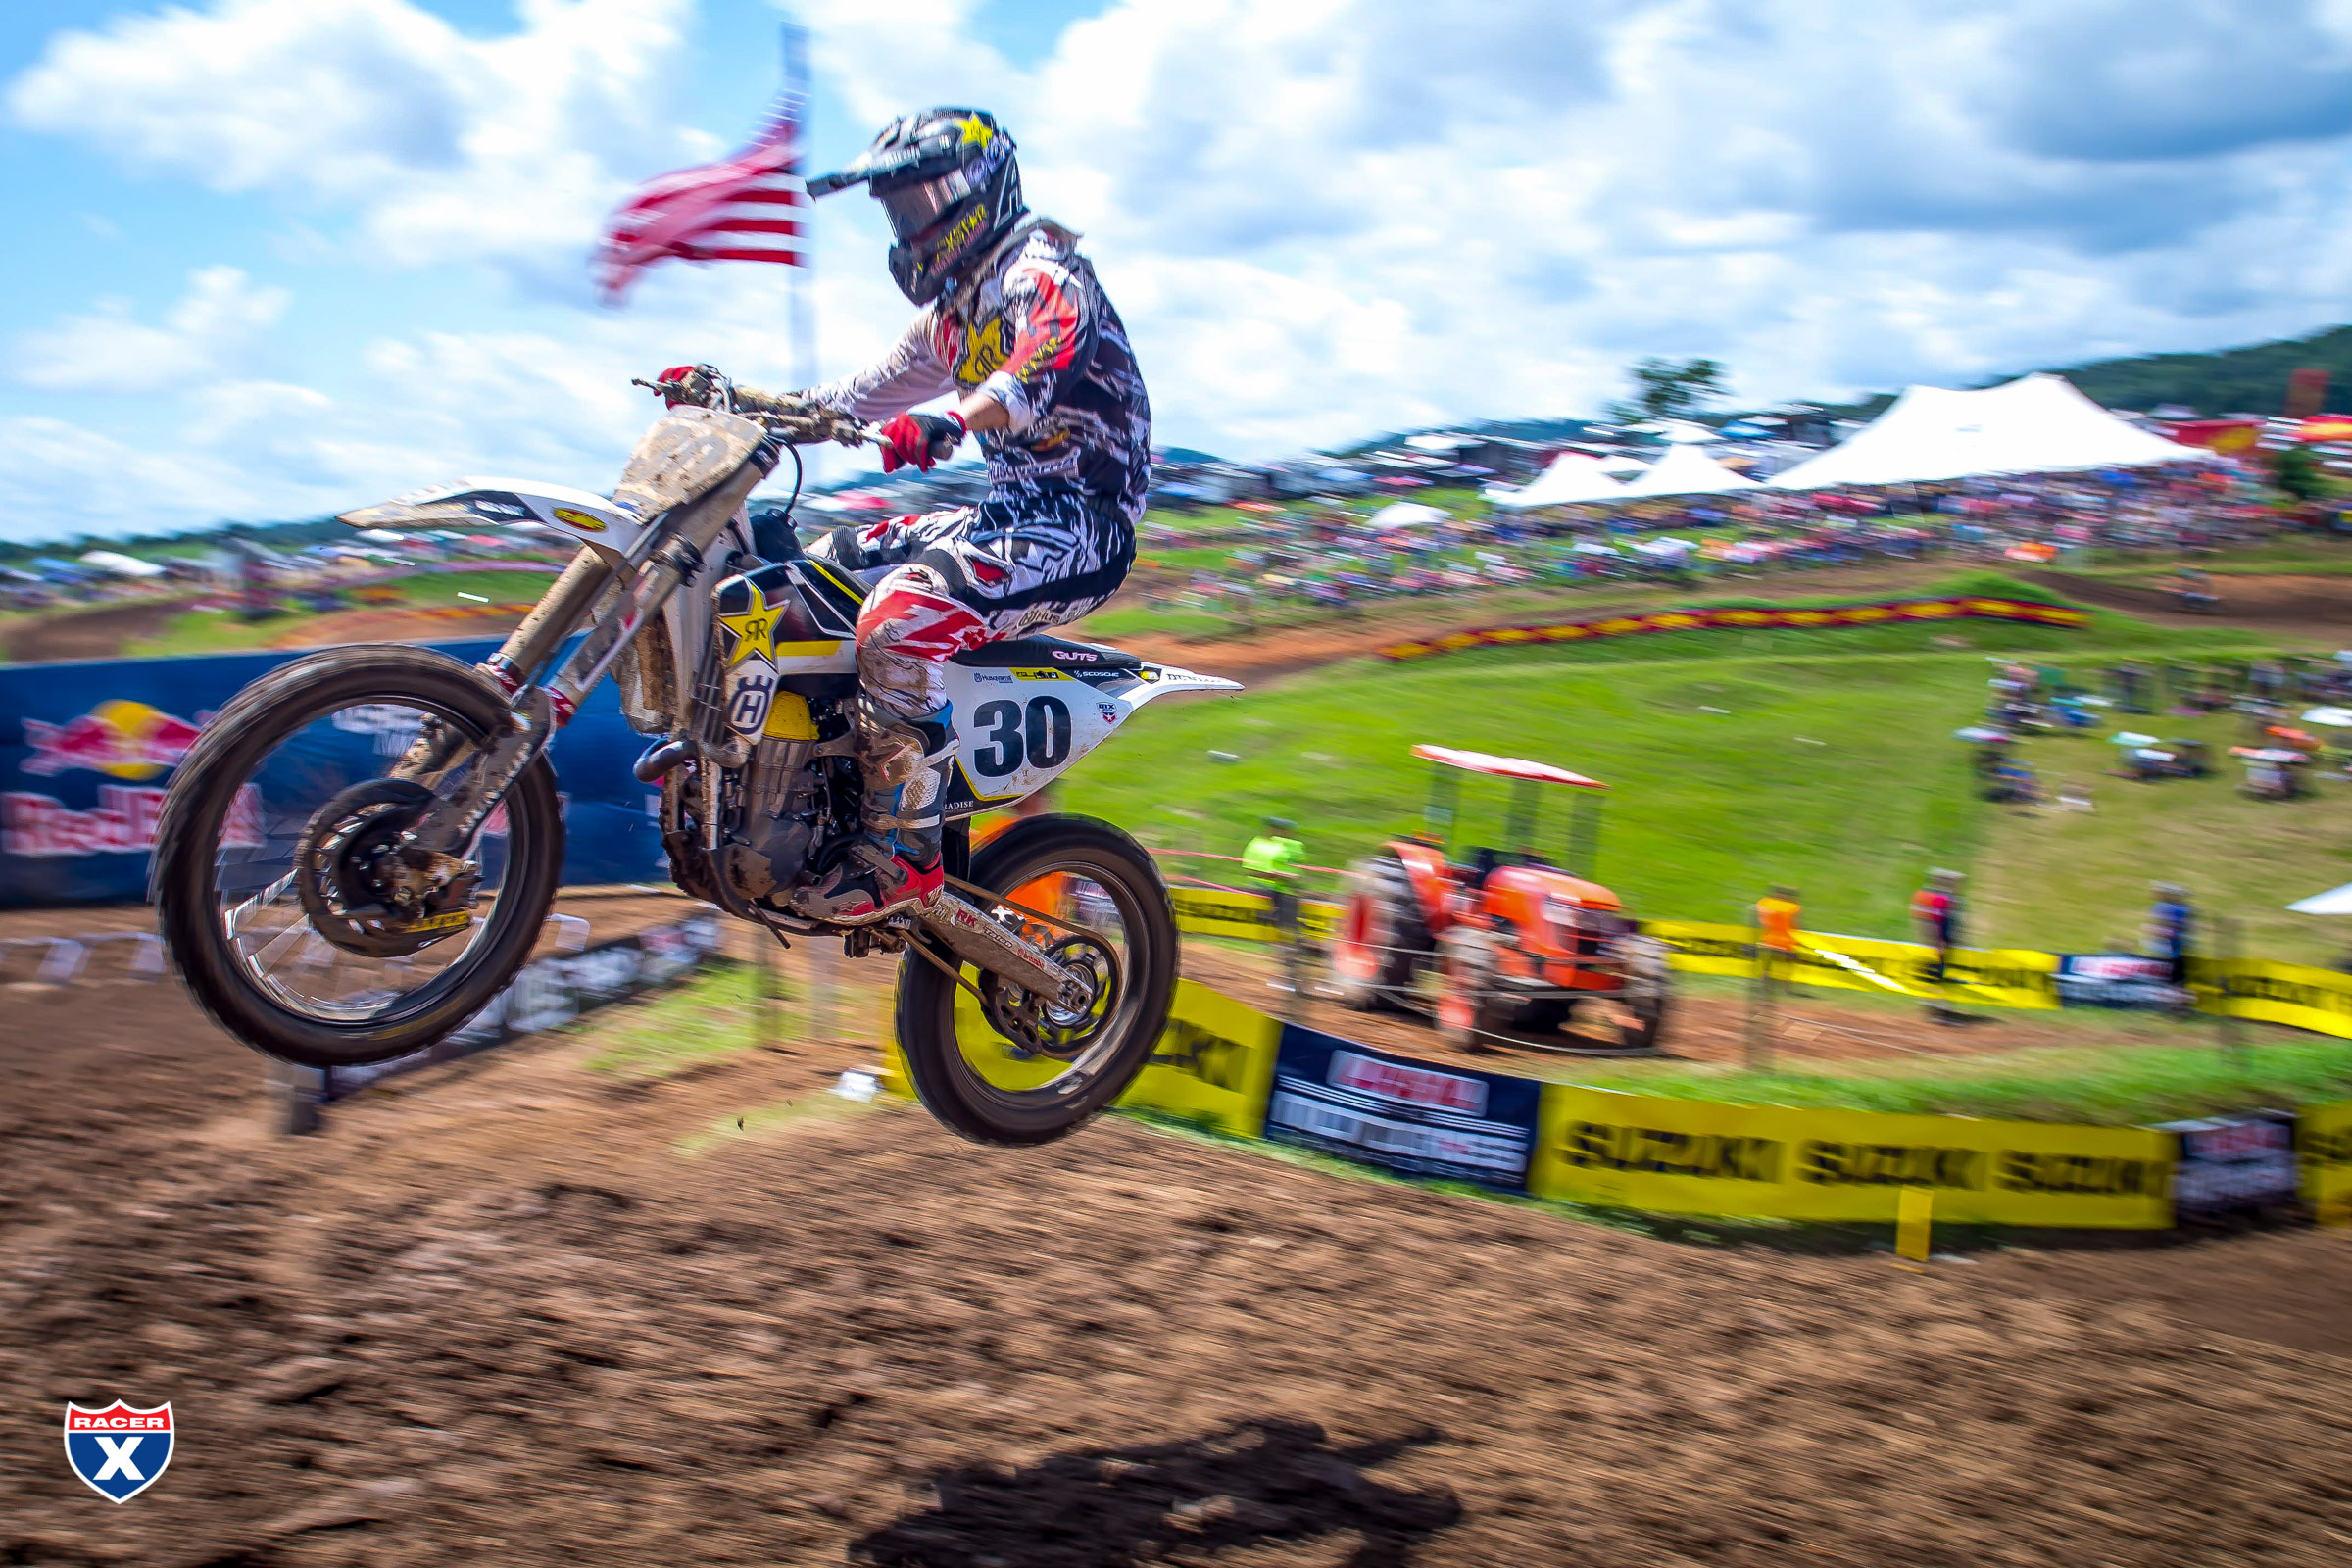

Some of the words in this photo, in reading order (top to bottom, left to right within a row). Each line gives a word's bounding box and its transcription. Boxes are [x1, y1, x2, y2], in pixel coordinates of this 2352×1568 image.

[1052, 650, 1098, 662] GUTS
[973, 695, 1072, 778] 30
[956, 908, 977, 929] RK
